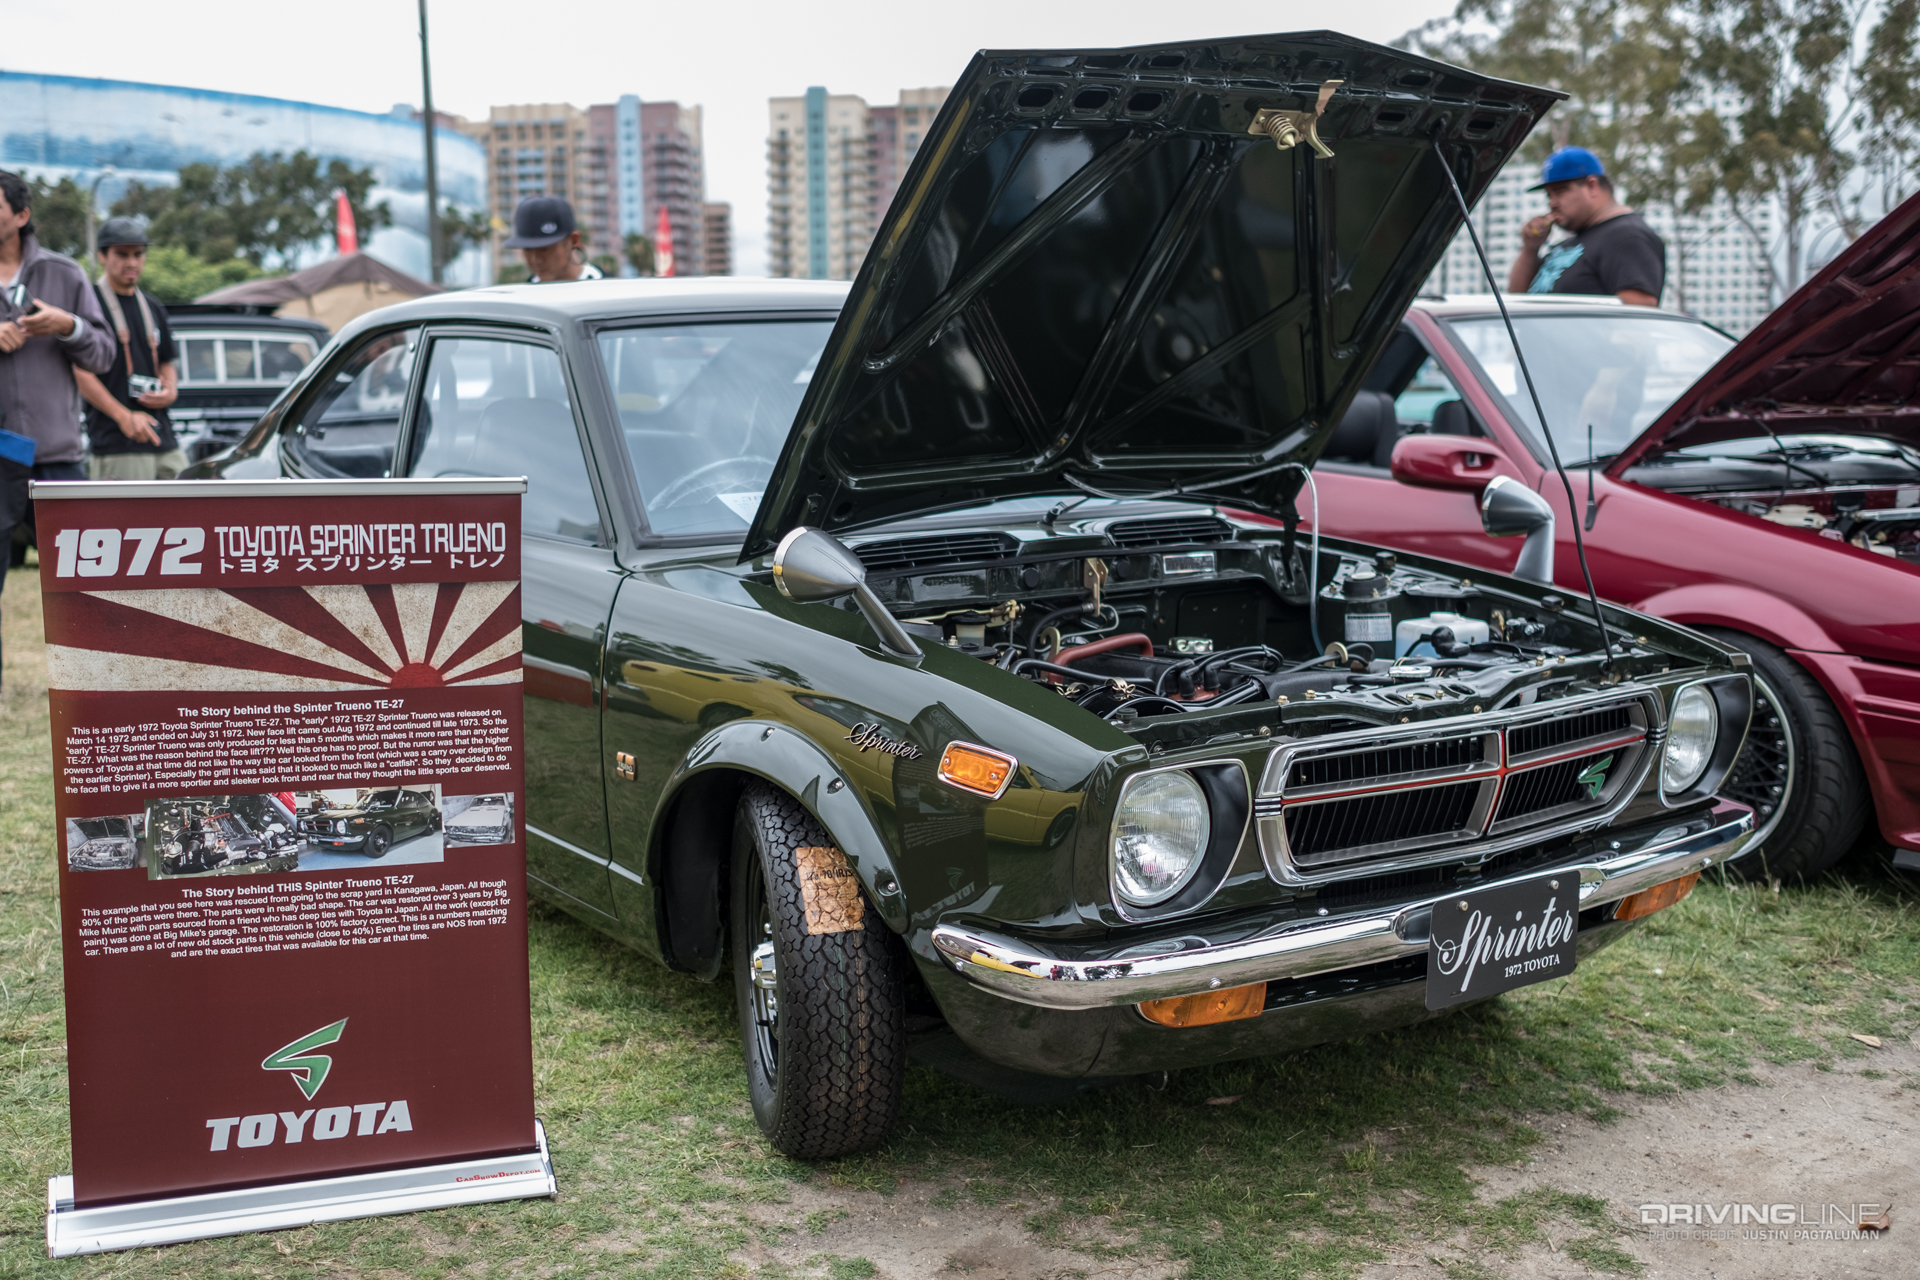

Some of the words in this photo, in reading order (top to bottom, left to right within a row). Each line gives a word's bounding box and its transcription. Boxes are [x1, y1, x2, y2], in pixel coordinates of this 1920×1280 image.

[54, 527, 206, 578] 1972
[214, 524, 305, 557] TOYOTA
[310, 523, 416, 556] SPRINTER
[420, 522, 506, 553] TRUENO
[220, 557, 280, 574] トヨタ
[296, 554, 432, 572] スプリンター
[450, 553, 505, 569] トレノ
[73, 725, 90, 734] This
[92, 725, 100, 733] is
[114, 724, 135, 734] early
[137, 722, 158, 731] 1972
[161, 721, 188, 732] Toyota
[189, 720, 223, 731] Sprinter
[225, 719, 253, 728] Trueno
[256, 717, 282, 726] TE-27.
[285, 717, 300, 725] The
[301, 715, 328, 726] "early"
[330, 714, 350, 723] 1972
[351, 713, 376, 722] TE-27
[377, 712, 409, 723] Sprinter
[410, 711, 438, 719] Trueno
[456, 708, 490, 717] released
[177, 706, 198, 717] The
[201, 705, 231, 718] Story
[233, 703, 271, 715] behind
[273, 703, 291, 713] the
[293, 701, 332, 715] Spinter
[334, 700, 372, 711] Trueno
[373, 698, 404, 709] TE-27
[65, 755, 94, 764] TE-27.
[95, 754, 119, 763] What
[139, 752, 153, 761] the
[155, 752, 183, 760] reason
[185, 749, 213, 758] behind
[215, 749, 229, 757] the
[230, 748, 248, 756] face
[250, 746, 274, 755] lift???
[276, 745, 294, 754] Well
[296, 745, 311, 753] this
[329, 743, 344, 751] has
[358, 741, 381, 752] proof.
[383, 740, 396, 749] But
[398, 739, 411, 748] the
[454, 736, 469, 745] that
[471, 736, 483, 744] the
[485, 735, 509, 746] higher
[843, 722, 923, 760] Sprinter
[65, 784, 78, 793] the
[79, 784, 98, 792] face
[100, 783, 111, 791] lift
[112, 782, 121, 791] to
[122, 782, 140, 793] give
[141, 781, 147, 789] it
[180, 778, 211, 789] sportier
[213, 777, 229, 786] and
[230, 776, 261, 785] sleeker
[262, 774, 279, 783] look
[280, 773, 300, 782] front
[301, 772, 316, 781] and
[336, 770, 352, 779] that
[353, 770, 371, 780] they
[372, 768, 402, 779] thought
[403, 767, 416, 776] the
[417, 766, 434, 775] little
[435, 765, 459, 776] sports
[474, 762, 511, 772] deserved.
[81, 907, 100, 916] This
[101, 905, 139, 916] example
[140, 903, 157, 912] that
[158, 903, 175, 913] you
[176, 902, 192, 910] see
[194, 900, 214, 908] here
[215, 899, 233, 907] was
[234, 895, 268, 905] rescued
[269, 895, 289, 903] from
[290, 892, 313, 904] going
[315, 891, 323, 900] to
[325, 890, 338, 899] the
[340, 890, 363, 899] scrap
[364, 887, 382, 899] yard
[384, 887, 392, 895] in
[393, 885, 438, 895] Kanagawa,
[439, 882, 466, 893] Japan.
[467, 880, 478, 889] All
[479, 878, 506, 889] though
[181, 887, 203, 898] The
[205, 886, 234, 898] Story
[237, 882, 274, 895] behind
[276, 881, 302, 892] THIS
[304, 879, 343, 893] Spinter
[345, 877, 382, 888] Trueno
[384, 873, 414, 885] TE-27
[83, 935, 108, 947] paint)
[109, 935, 127, 943] was
[129, 933, 151, 941] done
[152, 931, 161, 940] at
[163, 930, 177, 941] Big
[179, 928, 206, 938] Mike's
[207, 928, 239, 938] garage.
[243, 925, 258, 933] The
[260, 922, 303, 932] restoration
[305, 921, 313, 929] is
[315, 919, 338, 928] 100%
[340, 917, 367, 927] factory
[369, 914, 399, 924] correct.
[401, 913, 418, 922] This
[420, 912, 427, 920] is
[436, 910, 470, 919] numbers
[471, 907, 507, 917] matching
[170, 948, 187, 958] and
[204, 947, 218, 955] the
[220, 945, 243, 954] exact
[244, 944, 263, 953] tires
[264, 942, 281, 951] that
[282, 942, 299, 950] was
[301, 938, 337, 948] available
[338, 937, 350, 946] for
[351, 936, 366, 945] this
[382, 934, 391, 942] at
[392, 932, 408, 942] that
[409, 932, 429, 940] time.
[1432, 897, 1574, 993] Sprinter
[1504, 964, 1522, 978] 1972
[1524, 953, 1560, 973] TOYOTA
[206, 1100, 413, 1152] TOYOTA
